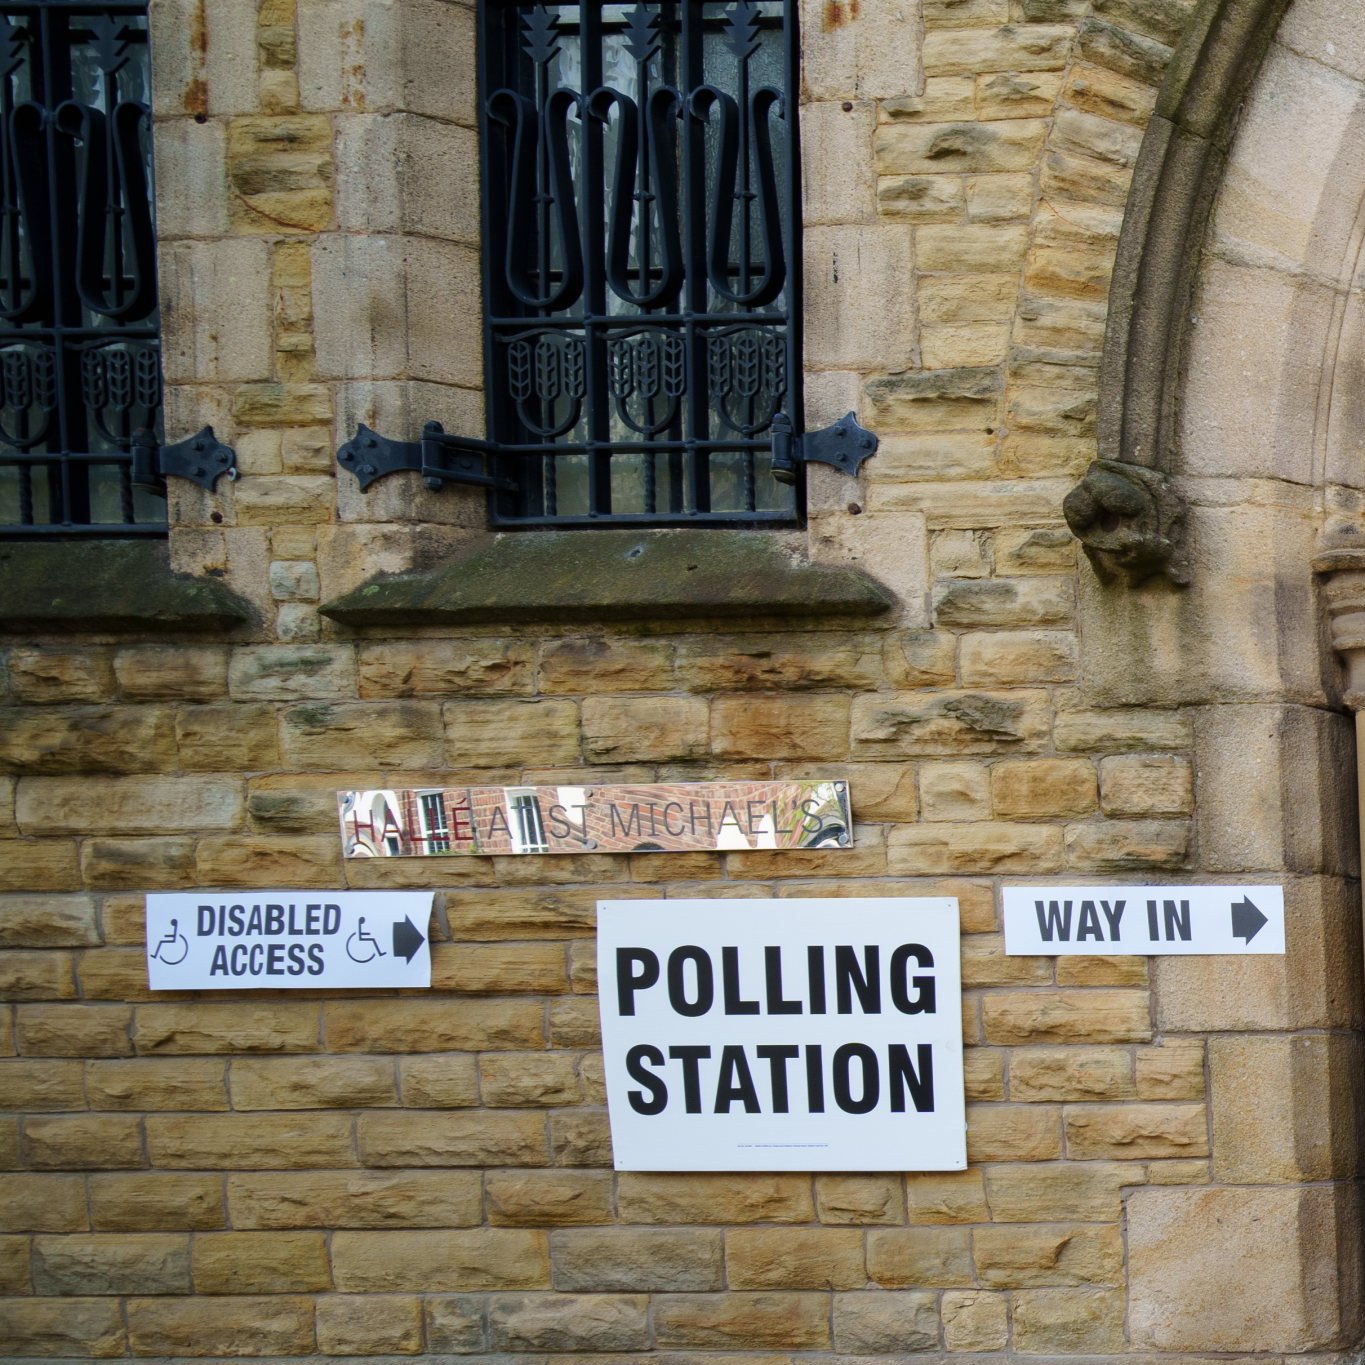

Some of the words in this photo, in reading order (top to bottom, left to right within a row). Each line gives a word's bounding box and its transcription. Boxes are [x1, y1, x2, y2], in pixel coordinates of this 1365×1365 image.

[353, 797, 474, 843] HALLÉ
[488, 804, 535, 839] AT
[550, 803, 594, 839] ST
[197, 904, 341, 936] DISABLED
[1034, 900, 1127, 942] WAY
[1146, 900, 1192, 941] IN
[210, 944, 325, 976] ACCESS
[615, 943, 937, 1018] POLLING
[625, 1042, 935, 1116] STATION
